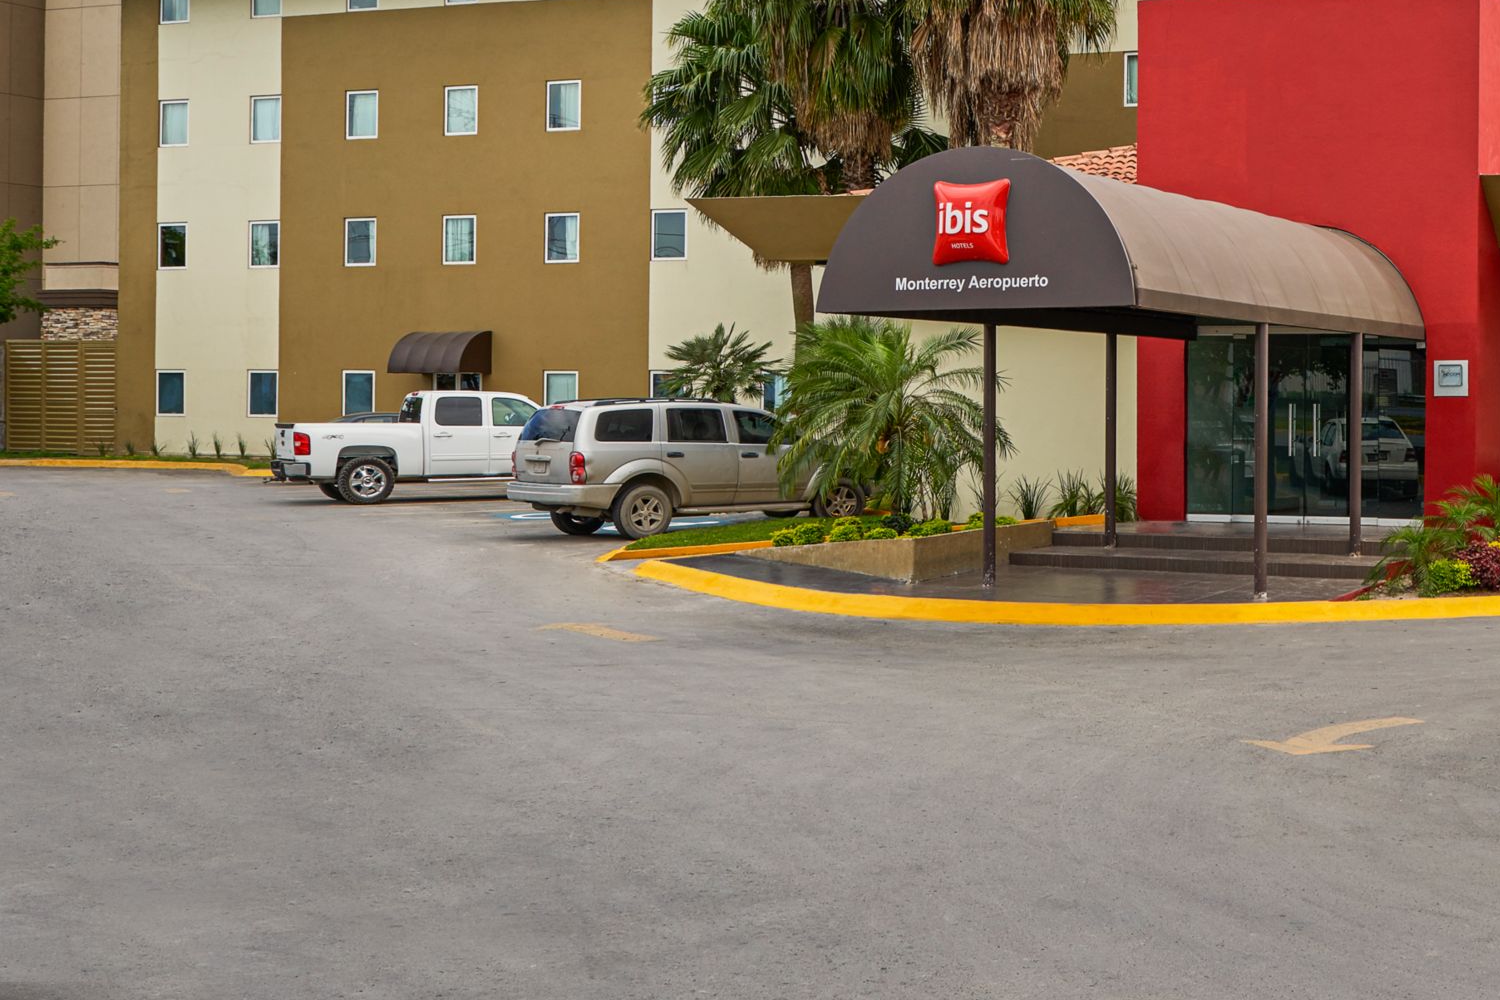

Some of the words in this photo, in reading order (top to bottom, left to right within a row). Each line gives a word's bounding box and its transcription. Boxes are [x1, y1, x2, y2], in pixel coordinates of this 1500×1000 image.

[938, 201, 989, 235] ibis
[895, 276, 966, 293] Monterrey
[967, 274, 1049, 291] Aeropuerto
